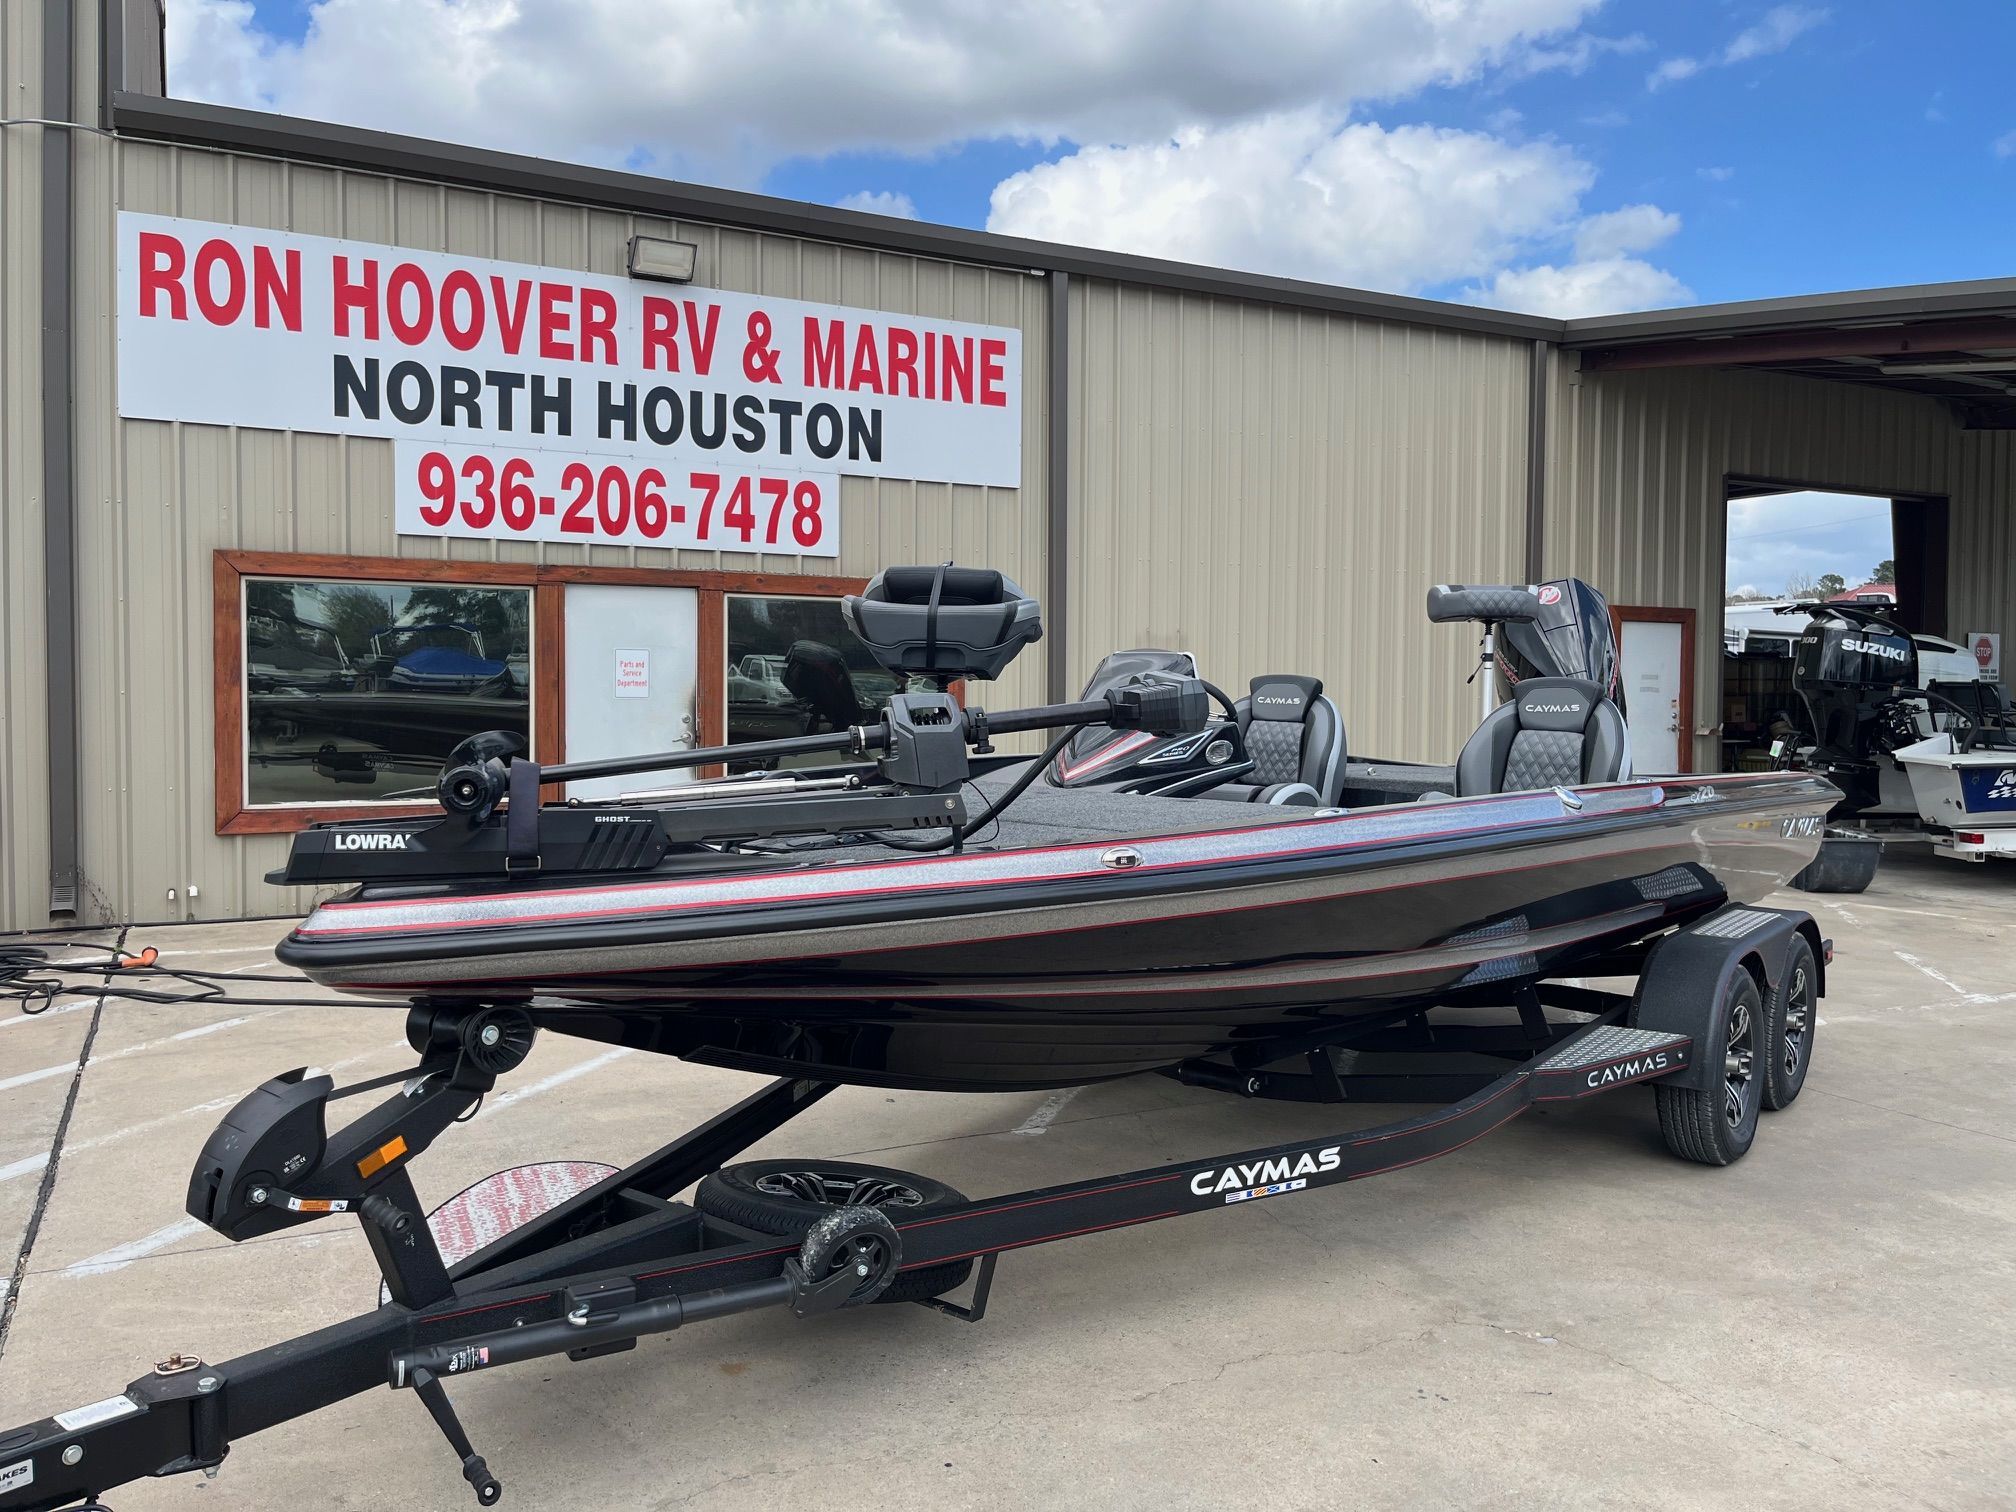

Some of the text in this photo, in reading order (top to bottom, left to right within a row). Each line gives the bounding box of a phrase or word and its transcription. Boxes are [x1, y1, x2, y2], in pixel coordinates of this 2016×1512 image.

[139, 232, 1007, 407] RON HOOVER RV & MARINE
[333, 354, 882, 463] NORTH HOUSTON
[418, 451, 823, 546] 936-206-7478
[1841, 638, 1905, 662] SUZUKI
[1976, 647, 1992, 657] STOP
[617, 679, 647, 688] Department
[1257, 696, 1301, 705] CAYMAS
[1525, 704, 1580, 713] CAYMAS
[1587, 1052, 1668, 1088] CAYMAS
[1190, 1146, 1341, 1196] CAYMAS
[0, 1465, 28, 1482] KES
